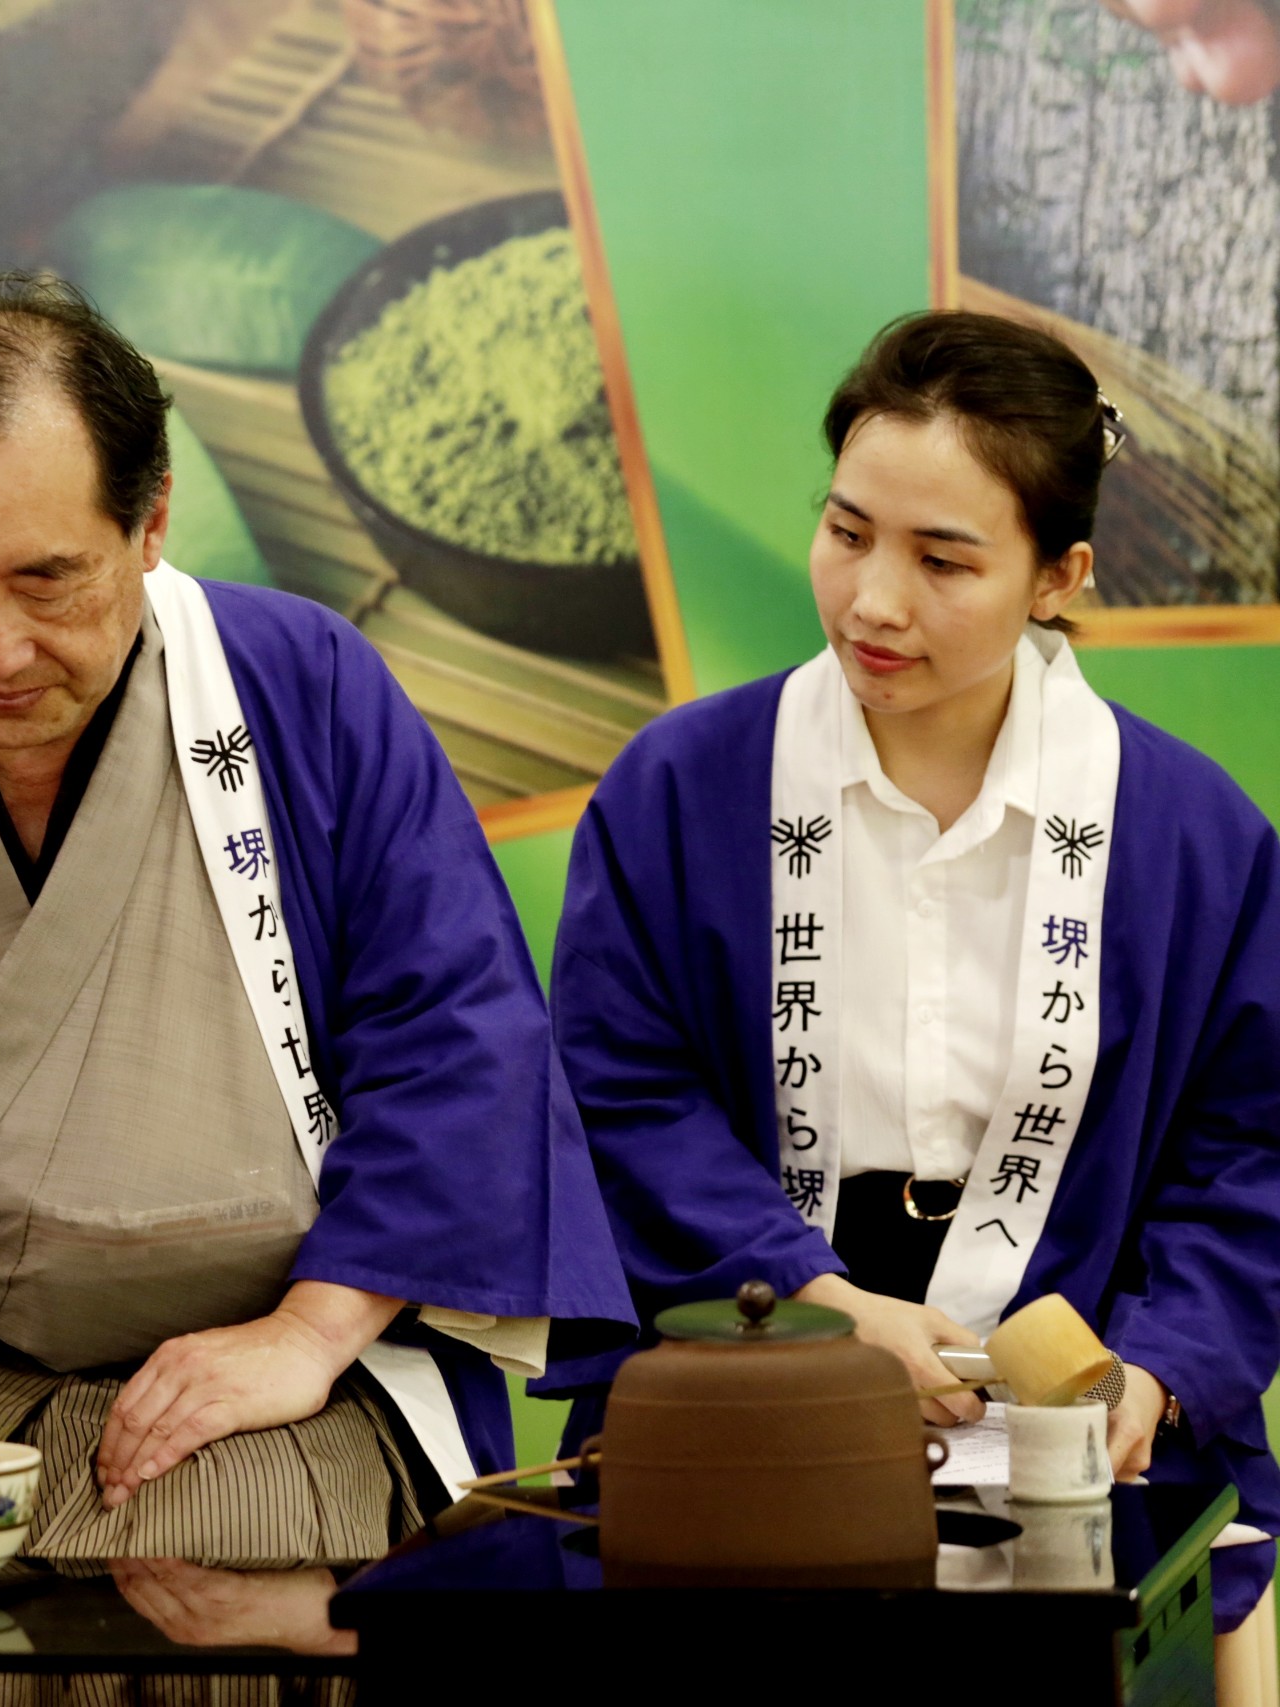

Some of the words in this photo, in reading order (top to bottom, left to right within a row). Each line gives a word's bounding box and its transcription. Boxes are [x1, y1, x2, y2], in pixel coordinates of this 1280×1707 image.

[772, 912, 824, 1217] 世界から堺
[975, 914, 1090, 1248] 堺から世界へ
